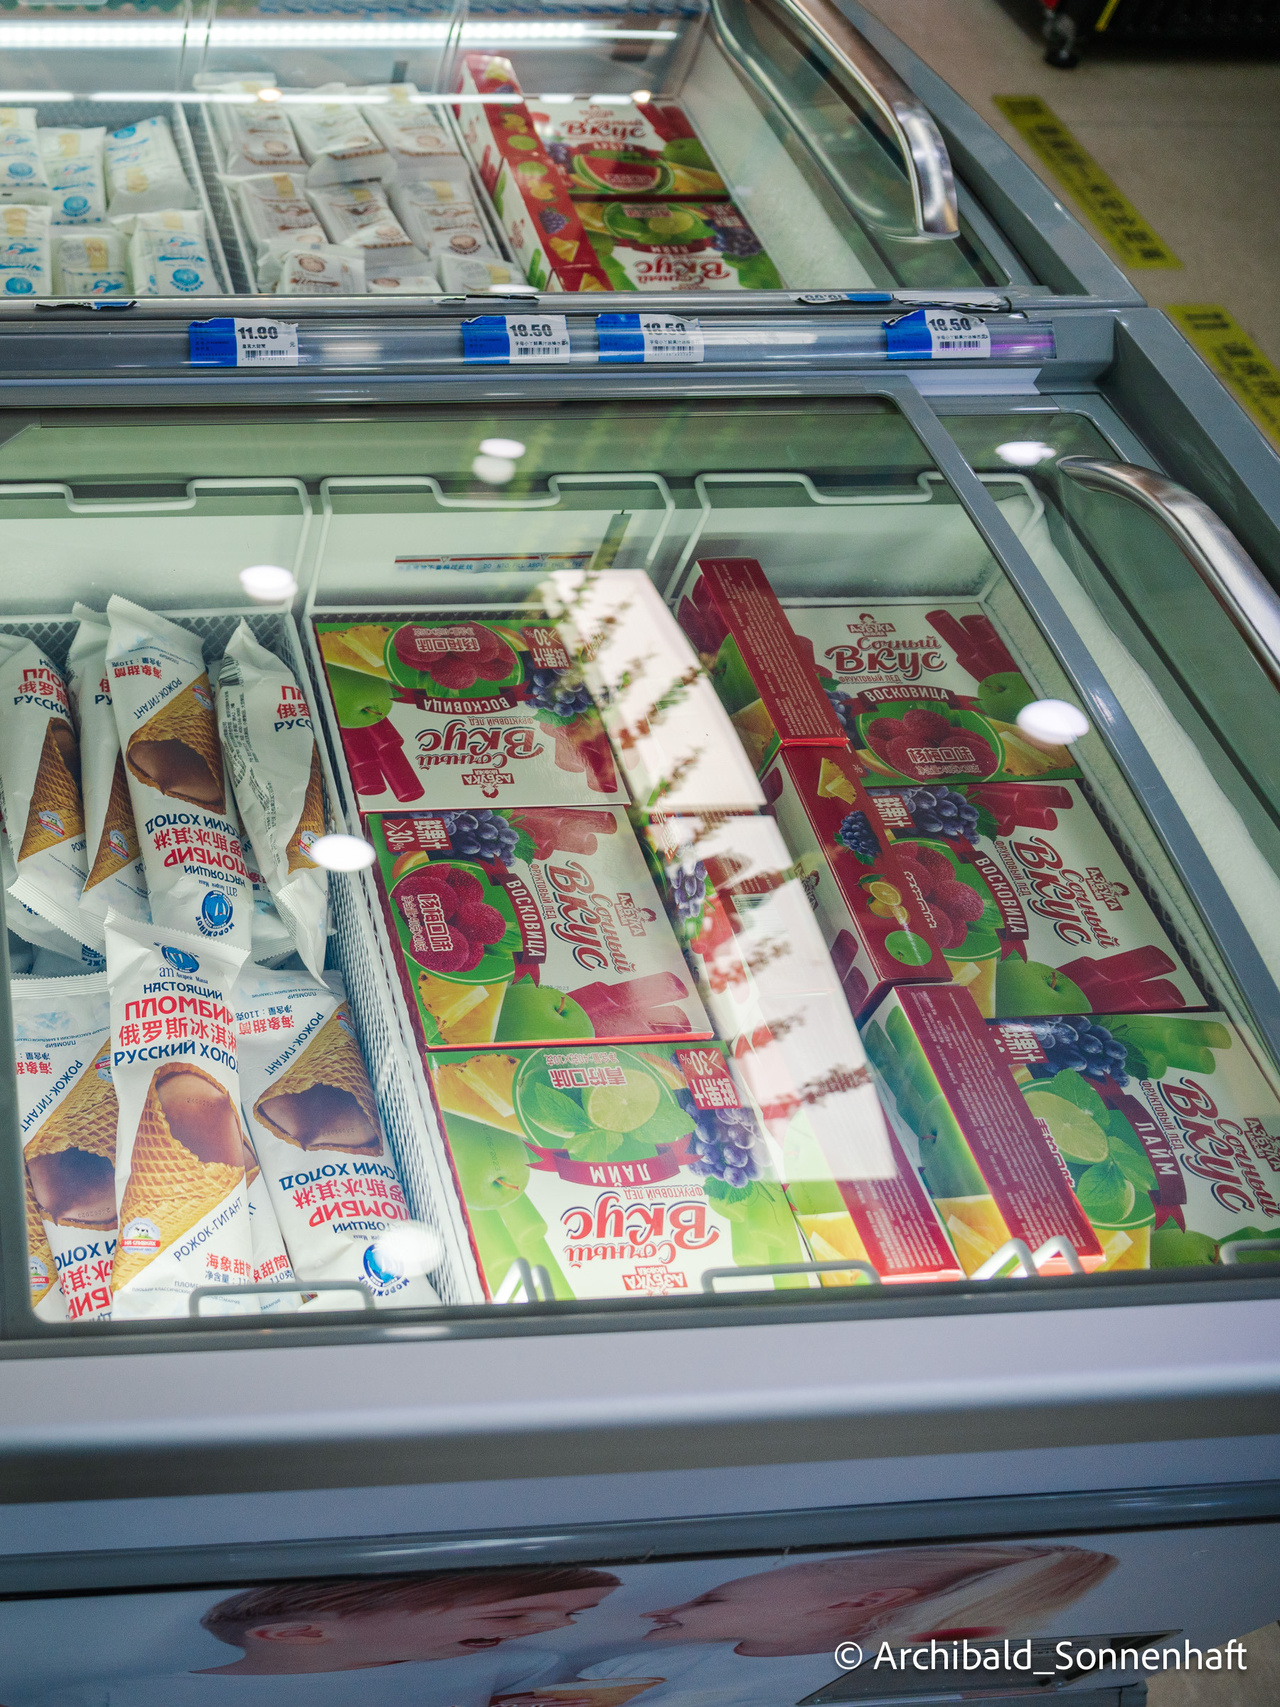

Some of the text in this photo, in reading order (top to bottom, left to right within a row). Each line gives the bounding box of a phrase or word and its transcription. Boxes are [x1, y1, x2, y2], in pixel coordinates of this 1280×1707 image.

[510, 324, 552, 336] 18.50
[929, 319, 971, 331] 18.50
[848, 622, 895, 634] АЗБУКА
[856, 634, 941, 650] Сочный
[416, 638, 480, 653] 杨梅口味
[823, 644, 948, 680] Вкус
[423, 698, 511, 713] ВОСКОВИЦА
[863, 686, 950, 702] ВОСКОВИЦА
[416, 720, 544, 759] Вкус
[416, 753, 508, 770] Сочный
[907, 746, 975, 764] 杨梅口味
[464, 773, 512, 784] АЗБУКА
[145, 813, 200, 836] ХОЛОД
[872, 797, 914, 829] 鲜果汁
[413, 820, 449, 850] 鲜果汁
[975, 856, 1028, 934] ВОСКОВИЦА
[1009, 836, 1091, 947] Вкус
[1086, 867, 1121, 911] АЗБУКА
[417, 892, 454, 952] 杨梅口味
[506, 880, 545, 957] ВОСКОВИЦА
[544, 860, 609, 971] Вкус
[618, 893, 646, 936] АЗБУКА
[1062, 869, 1120, 949] Сочный
[592, 894, 637, 974] Сочный
[143, 981, 223, 1000] НАСТОЯЩИЙ
[124, 997, 235, 1025] ПЛОМБИР
[239, 1014, 295, 1036] 海象甜筒
[113, 1040, 196, 1066] РУССКИЙ
[265, 1011, 325, 1076] РОЖОК-ГИГАНТ
[550, 1066, 626, 1089] 青柠口味
[21, 1059, 83, 1133] РОЖОК-ГИГАНТ
[1135, 1121, 1177, 1176] ЛАЙМ
[1158, 1077, 1254, 1214] Вкус
[278, 1163, 348, 1191] ХОЛОД
[590, 1164, 652, 1187] ЛАЙМ
[173, 1197, 245, 1261] РОЖОК-ГИГАНТ
[560, 1191, 720, 1250] Вкус
[564, 1239, 676, 1268] Сочный
[625, 1273, 685, 1290] АЗБУКА
